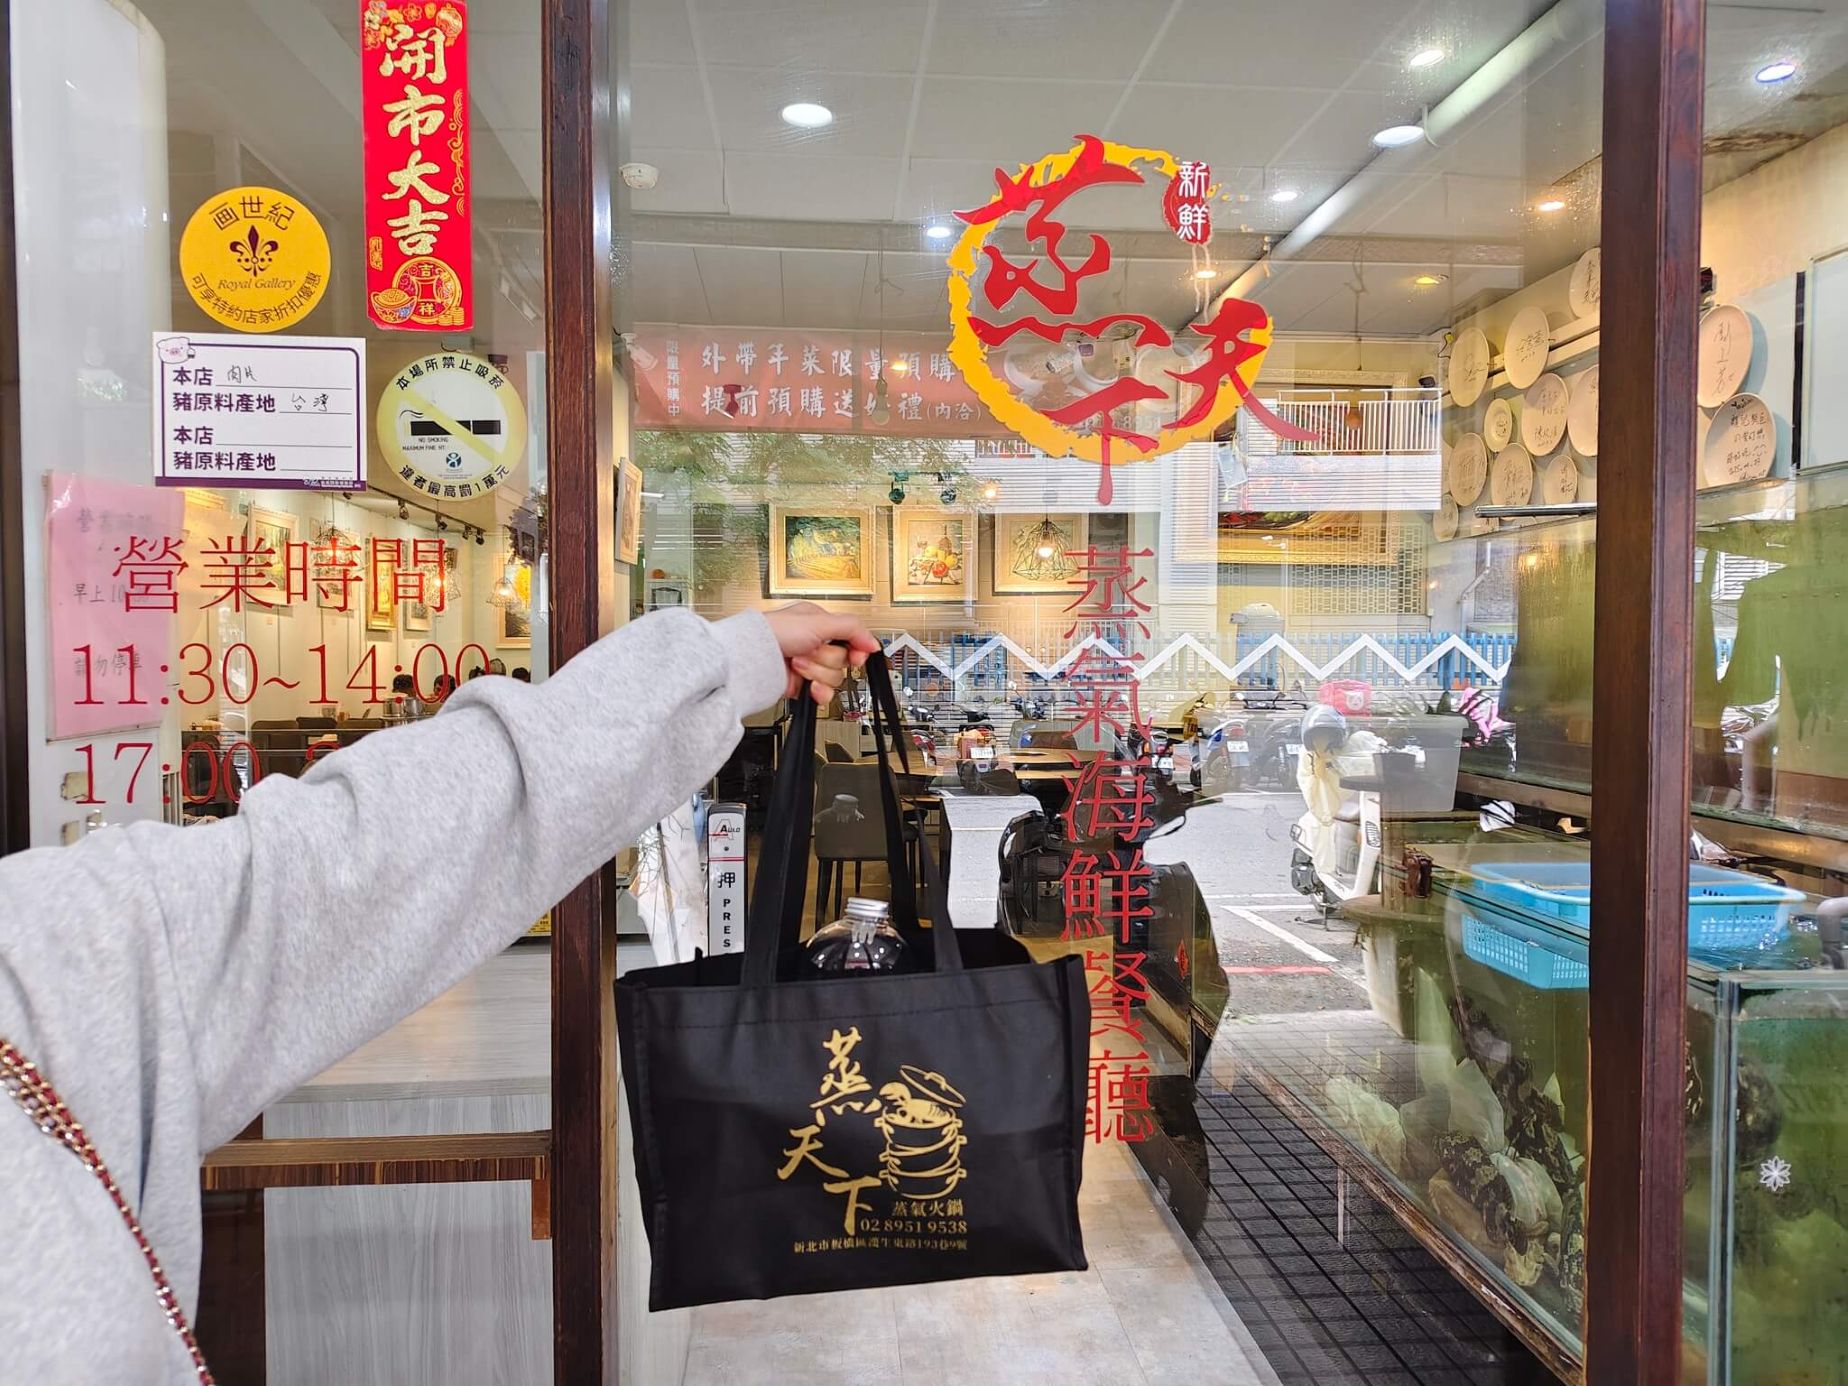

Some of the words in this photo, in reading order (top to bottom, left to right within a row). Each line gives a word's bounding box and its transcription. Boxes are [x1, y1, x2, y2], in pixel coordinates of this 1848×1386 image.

[379, 23, 450, 256] 開市大吉
[1177, 160, 1209, 241] 新鮮
[192, 271, 322, 324] 可享特約店家折扣優惠
[218, 279, 250, 292] Royal
[255, 278, 296, 291] Gallery
[173, 367, 213, 386] 本店
[173, 392, 276, 413] 豬原料產地
[173, 426, 213, 446] 本店
[173, 451, 276, 471] 豬原料產地
[112, 535, 446, 614] 營業時間
[73, 642, 491, 705] 11:30~14:00
[74, 741, 341, 806] 17:00
[1061, 543, 1154, 1144] 蒸氣海鮮餐廳
[717, 872, 736, 889] 押
[722, 898, 732, 954] PRES
[777, 1025, 882, 1237] 蒸天下
[860, 1218, 881, 1232] 02
[884, 1219, 922, 1233] 8951
[927, 1220, 968, 1234] 9538
[892, 1199, 965, 1217] 蒸氣火鍋
